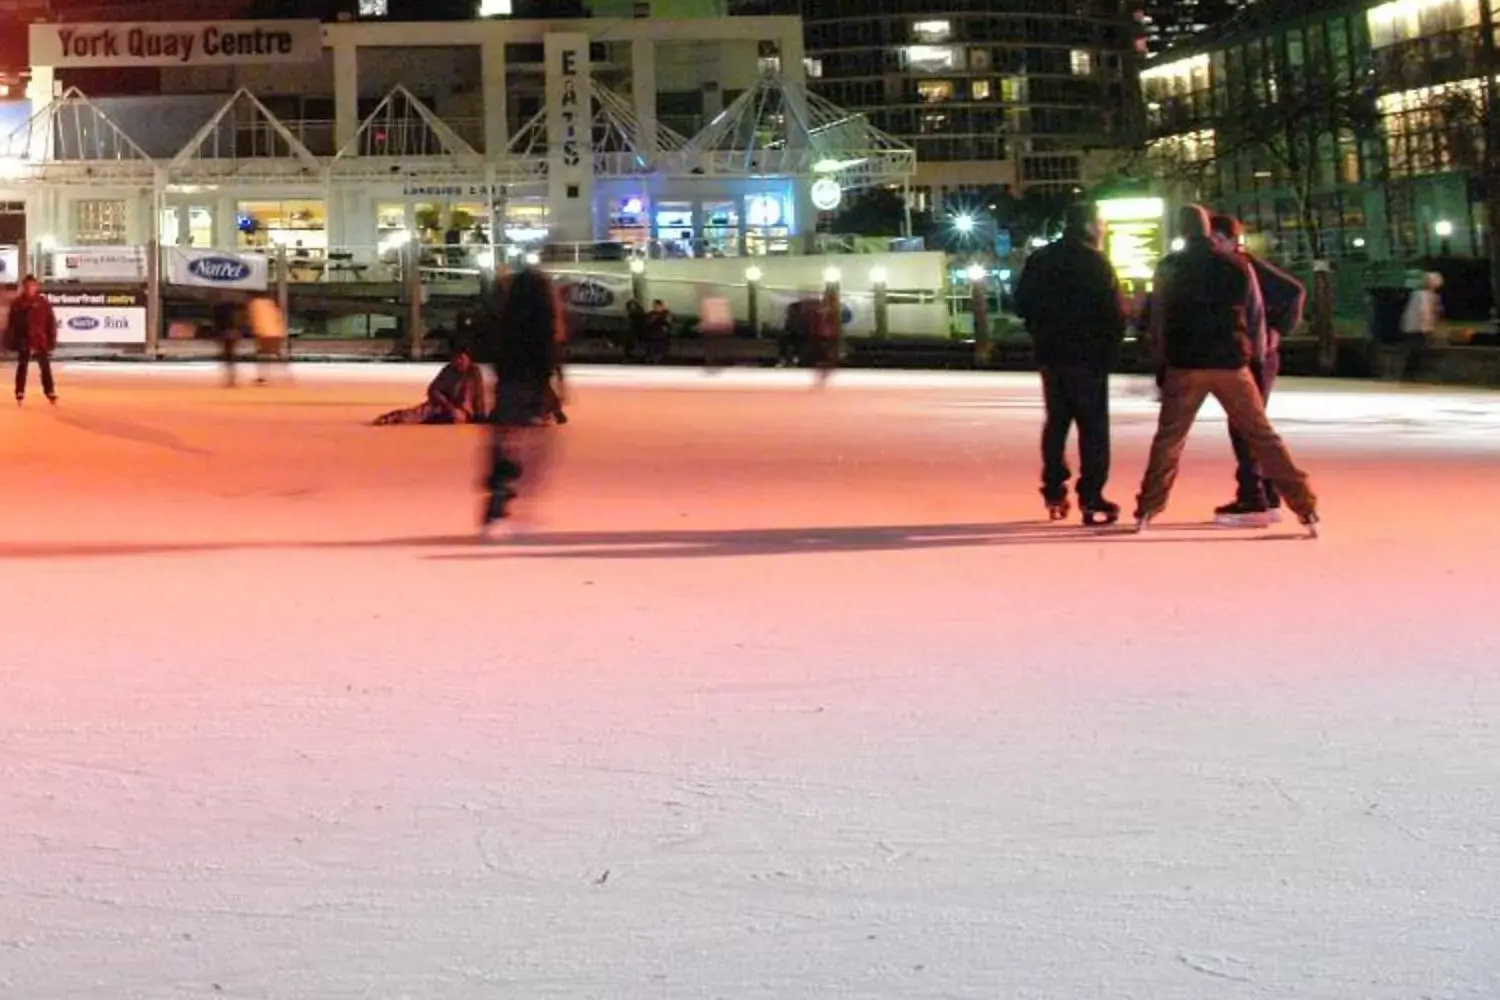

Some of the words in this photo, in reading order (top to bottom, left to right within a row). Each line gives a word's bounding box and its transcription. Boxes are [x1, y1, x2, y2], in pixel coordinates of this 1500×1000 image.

[57, 28, 120, 57] York
[127, 28, 196, 62] Quay
[202, 27, 293, 56] Centre
